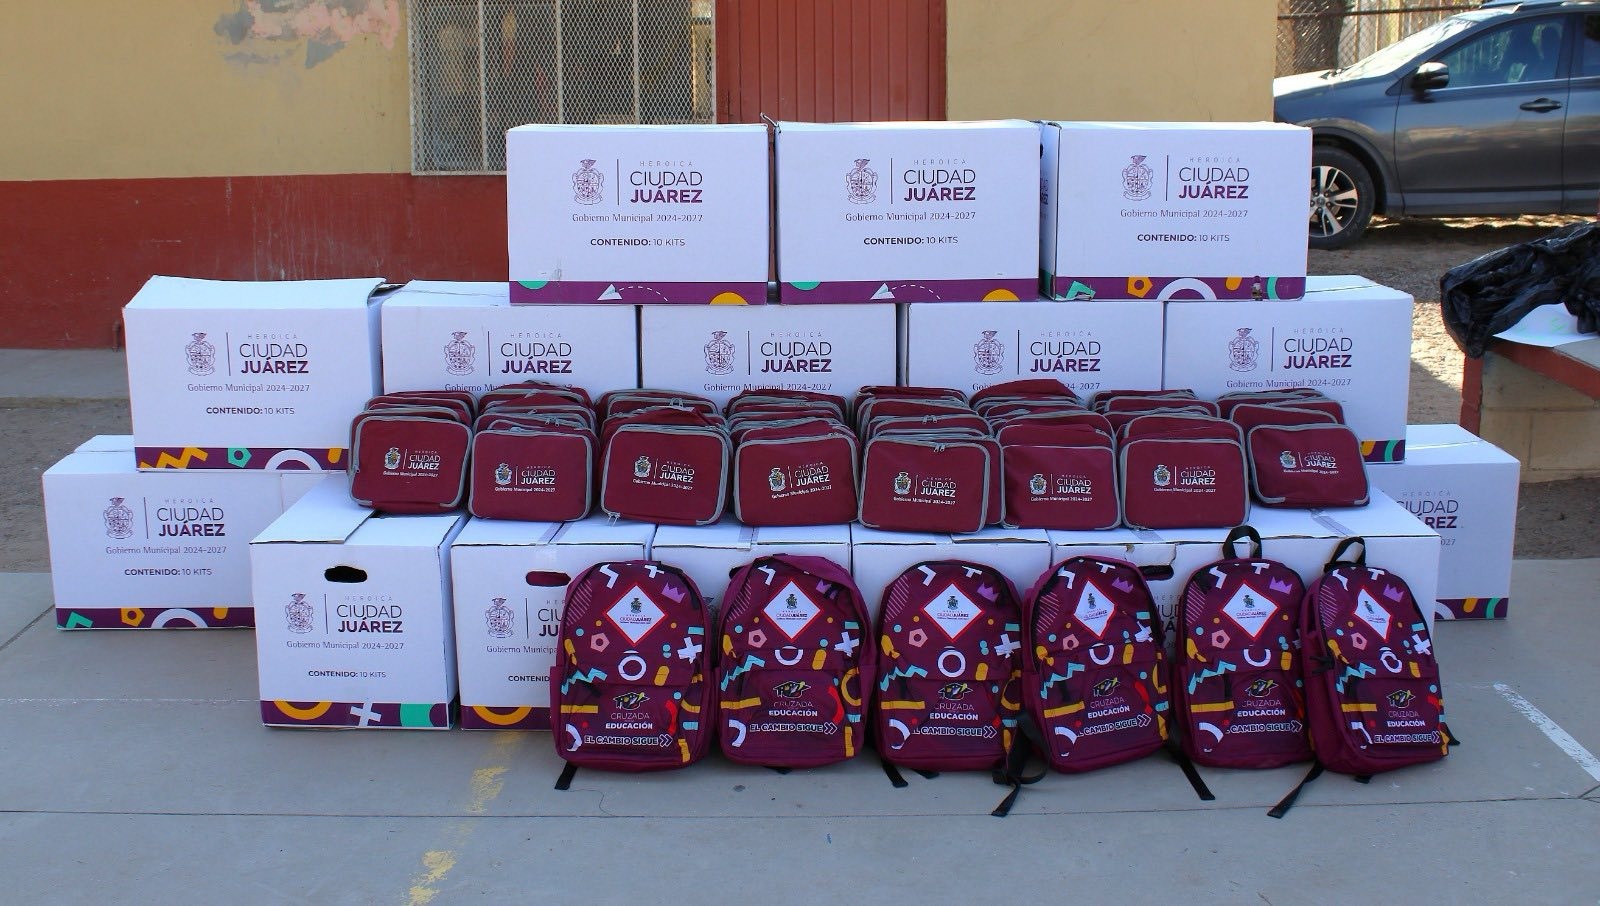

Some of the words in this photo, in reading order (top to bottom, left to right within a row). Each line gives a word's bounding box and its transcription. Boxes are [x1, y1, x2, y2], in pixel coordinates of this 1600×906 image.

[630, 171, 703, 186] CIUDAD
[904, 169, 976, 184] CIUDAD
[1179, 167, 1250, 182] CIUDAD
[631, 185, 703, 203] JUÁREZ
[904, 183, 976, 201] JUÁREZ
[1179, 181, 1249, 199] JUÁREZ
[573, 214, 610, 222] Gobierno
[613, 214, 653, 223] Municipal
[656, 214, 703, 222] 2024-2027
[846, 212, 883, 221] Gobierno
[886, 212, 927, 222] Municipal
[930, 211, 976, 221] 2024-2027
[1120, 209, 1158, 218] Gobierno
[1160, 209, 1200, 220] Municipal
[1203, 209, 1248, 218] 2024-2027
[863, 237, 924, 245] CONTENIDO:
[938, 236, 959, 244] KITS
[1137, 234, 1197, 242] CONTENIDO:
[1199, 234, 1208, 242] 10
[1210, 234, 1230, 242] KITS
[240, 343, 308, 358] CIUDAD
[501, 342, 572, 357] CIUDAD
[761, 341, 832, 357] CIUDAD
[1030, 341, 1101, 356] CIUDAD
[1284, 337, 1353, 353] CIUDAD
[241, 356, 309, 374] JUÁREZ
[501, 355, 572, 374] JUÁREZ
[760, 355, 832, 373] JUÁREZ
[1030, 354, 1101, 372] JUÁREZ
[1283, 351, 1352, 370] JUÁREZ
[187, 383, 223, 392] Gobierno
[225, 383, 264, 393] Municipal
[266, 384, 310, 392] 2024-2027
[1226, 380, 1263, 388] Gobierno
[1266, 378, 1304, 389] Municipal
[1307, 379, 1352, 387] 2024-2027
[206, 407, 262, 415] CONTENIDO:
[264, 407, 274, 415] 10
[276, 407, 295, 415] KITS
[409, 455, 441, 463] CIUDAD
[1304, 454, 1336, 462] CIUDAD
[408, 462, 440, 470] JUÁREZ
[661, 464, 695, 476] CIUDAD
[1306, 460, 1337, 469] JUÁREZ
[521, 470, 556, 478] CIUDAD
[795, 465, 829, 478] CIUDAD
[1180, 469, 1216, 478] CIUDAD
[521, 476, 555, 485] JUÁREZ
[659, 472, 694, 483] JUÁREZ
[796, 473, 830, 487] JUÁREZ
[1056, 478, 1092, 487] CIUDAD
[1180, 477, 1216, 485] JUÁREZ
[921, 479, 957, 489] CIUDAD
[1057, 485, 1092, 494] JUÁREZ
[920, 487, 956, 498] JUÁREZ
[1397, 499, 1459, 514] IUDAD
[157, 507, 224, 522] CIUDAD
[1420, 514, 1458, 529] REZ
[158, 520, 226, 537] JUÁREZ
[106, 546, 140, 554] Gobierno
[143, 546, 181, 555] Municipal
[124, 568, 181, 576] CONTENIDO:
[337, 604, 403, 619] CIUDAD
[338, 616, 403, 633] JUÁREZ
[286, 640, 321, 649] Gobierno
[323, 641, 359, 651] Municipal
[523, 646, 558, 654] Municipa
[308, 670, 358, 678] CONTENIDO:
[1090, 696, 1125, 709] CRUZADA
[610, 712, 650, 720] CRUZADA
[768, 709, 818, 717] EDUCACIÓN
[929, 712, 978, 721] EDUCACIÓN
[1087, 704, 1130, 719] EDUCACIÓN
[1237, 708, 1286, 717] EDUCACIÓN
[605, 721, 653, 730] EDUCACIÓN
[750, 723, 761, 732] EL
[761, 723, 796, 732] CAMBIO
[796, 723, 824, 732] SIGUE
[1083, 723, 1115, 736] CAMBIO
[1114, 718, 1138, 730] SIGUE
[1230, 723, 1266, 734] CAMBIO
[1266, 723, 1291, 732] SIGUE
[1386, 719, 1426, 727] EDUCACIÓN
[920, 726, 956, 735] CAMBIO
[956, 728, 983, 736] SIGUE
[584, 735, 595, 744] EL
[595, 735, 631, 745] CAMBIO
[631, 736, 659, 746] SIGUE
[1374, 734, 1385, 743] EL
[1384, 734, 1411, 743] CAMBIO
[1411, 733, 1432, 743] SIGUE
